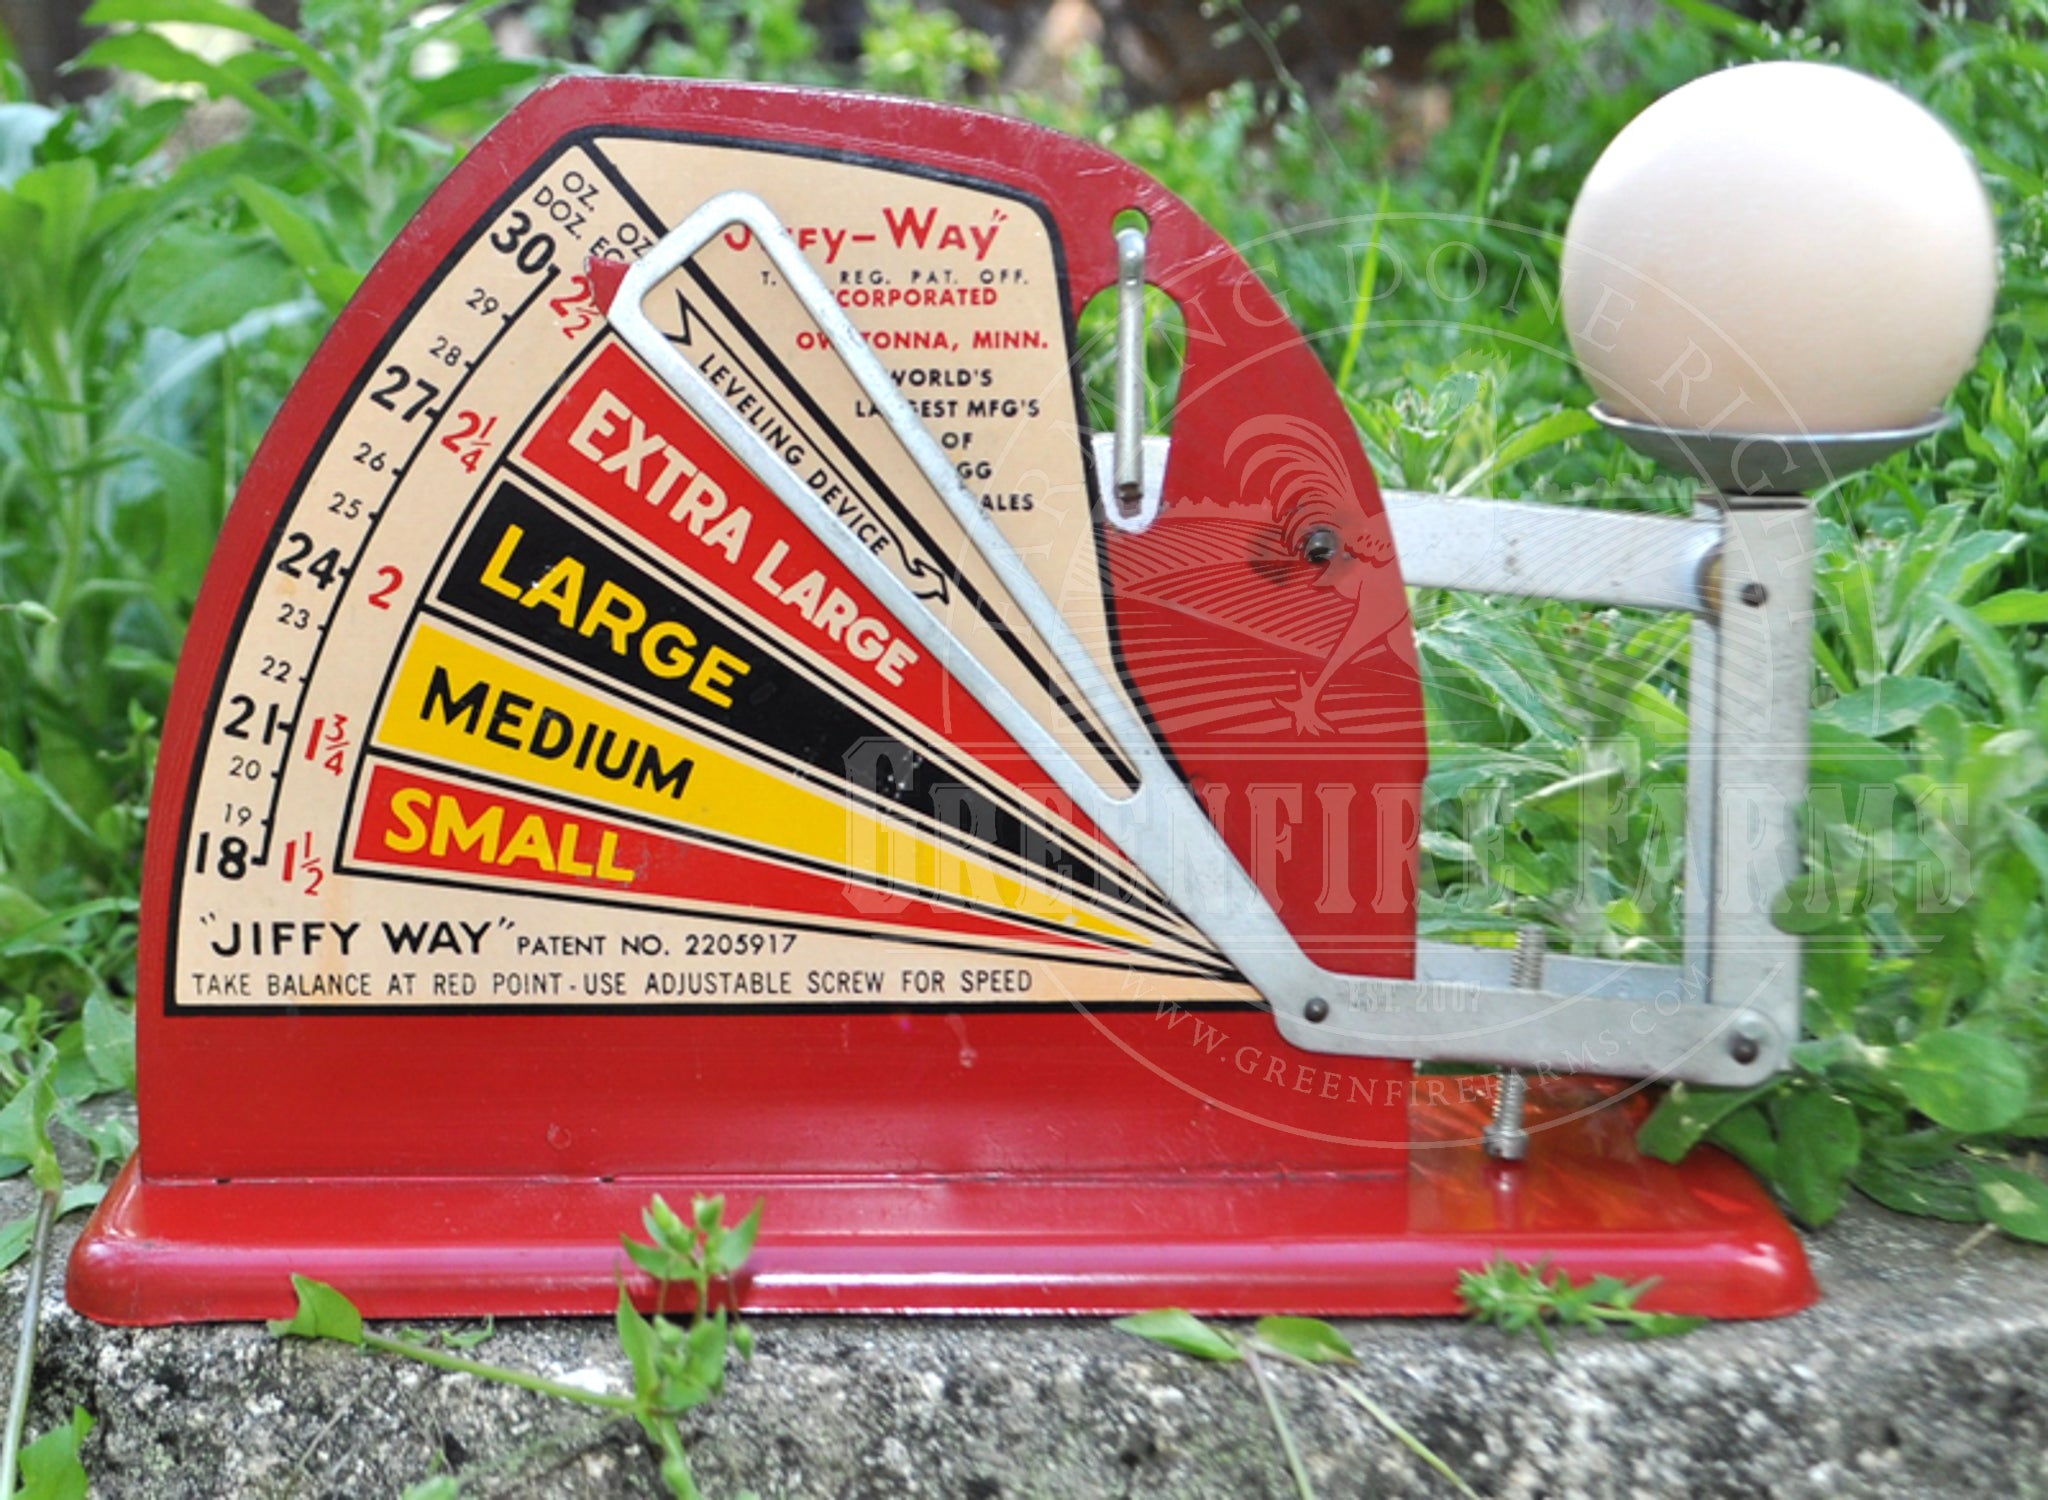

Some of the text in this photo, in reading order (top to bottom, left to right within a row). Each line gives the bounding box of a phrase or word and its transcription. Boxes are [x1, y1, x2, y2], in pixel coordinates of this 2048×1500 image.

[563, 171, 599, 212] OZ.
[534, 185, 586, 240] DOZ.
[490, 210, 557, 275] 30
[840, 270, 892, 286] REG.
[911, 270, 959, 286] PAT.
[980, 270, 1029, 286] OFF.
[465, 287, 500, 315] 29
[833, 288, 998, 307] CORPORATED
[429, 336, 463, 367] 28
[972, 331, 1049, 349] MINN.
[370, 365, 441, 423] 27
[967, 400, 1040, 418] MFG'S
[698, 353, 892, 556] LEVELING DEVICE
[941, 432, 974, 449] OF
[353, 442, 387, 472] 26
[956, 461, 993, 480] GG
[328, 491, 363, 519] 25
[568, 388, 920, 688] EXTRA LARGE
[276, 532, 342, 590] 24
[368, 565, 405, 610] 2
[277, 603, 310, 629] 23
[479, 523, 752, 710] LARGE
[260, 655, 293, 683] 22
[223, 693, 280, 746] 21
[419, 665, 695, 801] MEDIUM
[228, 756, 262, 782] 20
[223, 802, 253, 825] 19
[384, 787, 636, 883] SMALL
[194, 831, 249, 881] 18
[199, 912, 797, 957] "JIFFY WAY" PATENT NO. 2205917
[192, 973, 252, 996] TAKE
[267, 973, 372, 996] BALANCE
[387, 972, 416, 996] AT
[433, 972, 477, 996] RED
[644, 972, 792, 995] ADJUSTABLE
[807, 971, 884, 993] SCREW
[903, 970, 944, 992] FOR
[961, 970, 1033, 993] SPEED
